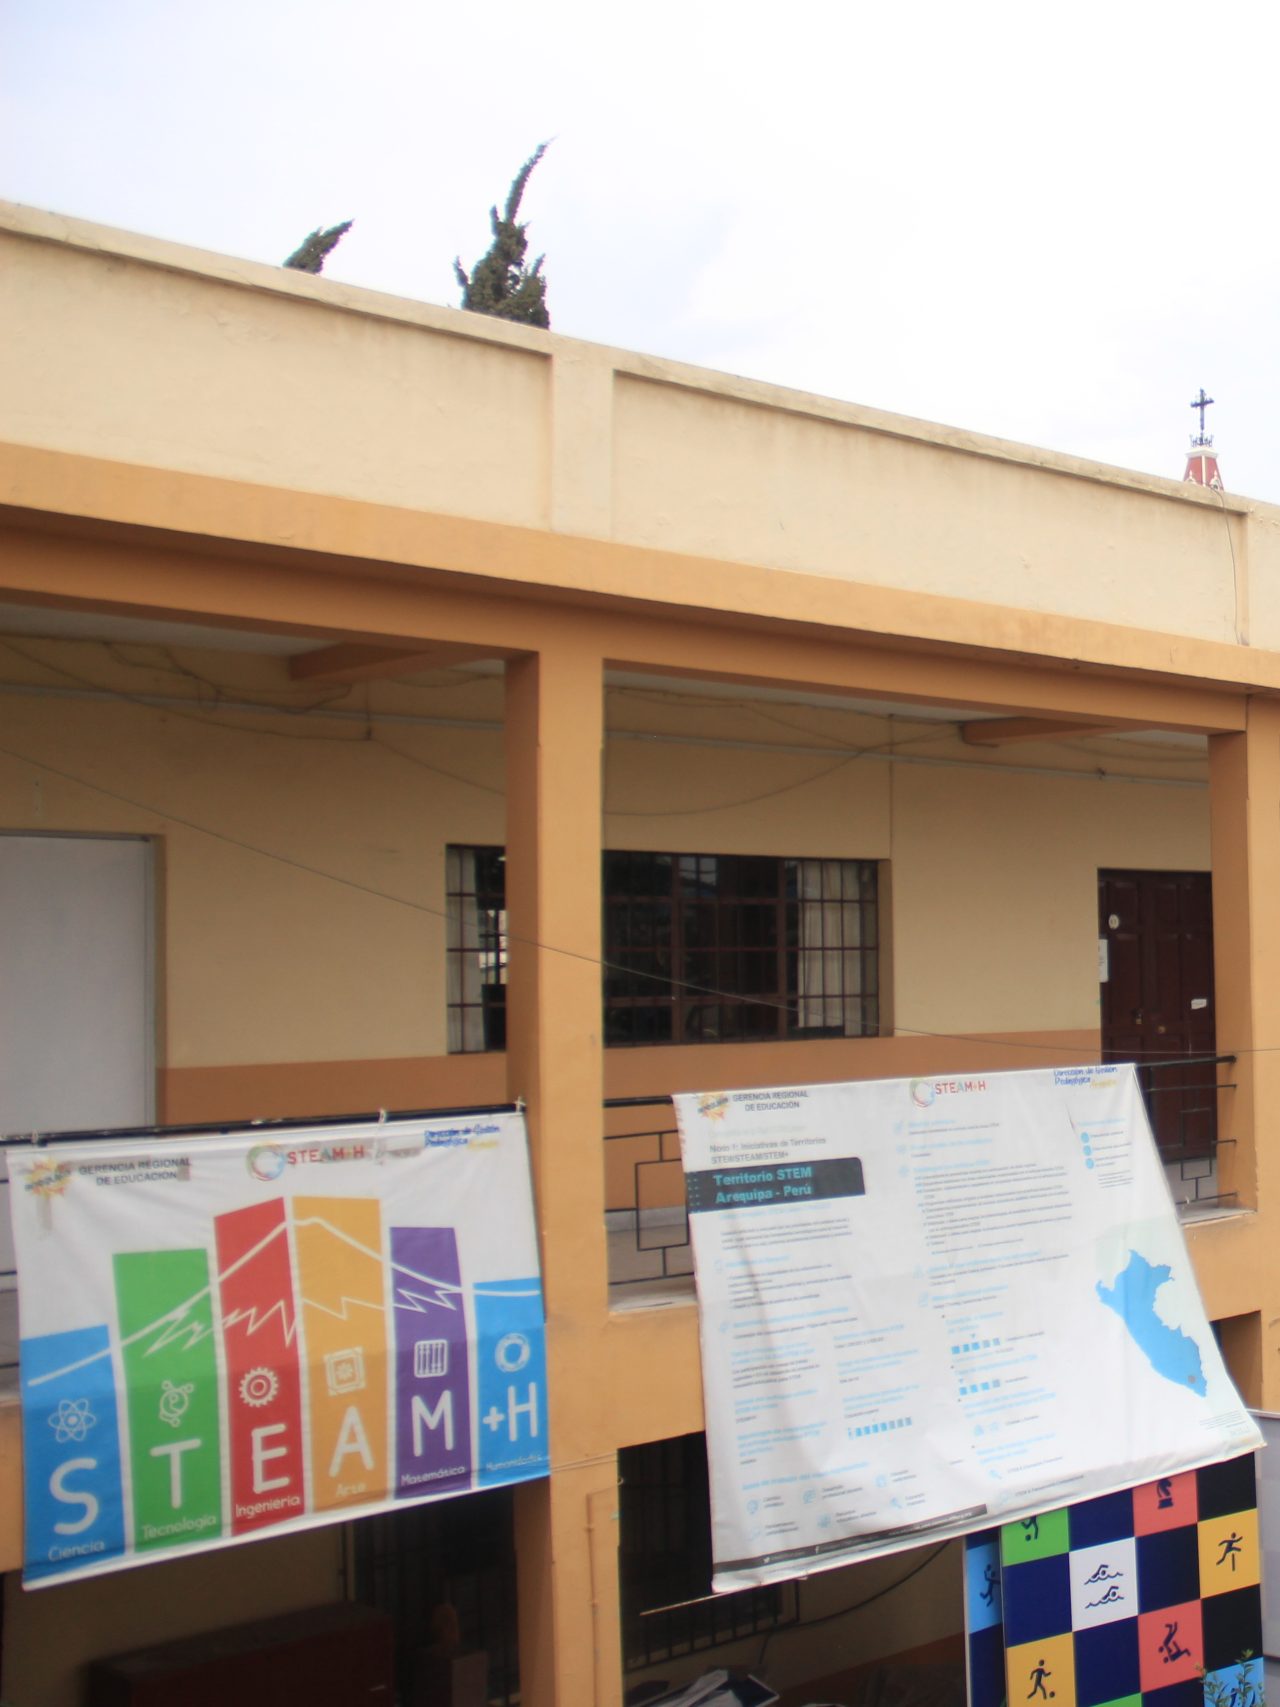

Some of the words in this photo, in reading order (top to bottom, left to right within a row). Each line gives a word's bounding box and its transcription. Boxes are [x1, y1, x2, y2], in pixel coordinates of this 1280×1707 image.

[733, 1092, 771, 1102] GERENCIA
[772, 1090, 809, 1099] REGIONAL
[745, 1103, 756, 1111] DE
[78, 1162, 135, 1175] GERENCIA
[138, 1158, 191, 1169] REGIONAL
[96, 1176, 111, 1186] DE
[713, 1171, 773, 1186] Territorio
[776, 1166, 812, 1181] STEM
[715, 1188, 773, 1204] Arequipa
[783, 1183, 812, 1197] Perú
[50, 1458, 98, 1534] S
[150, 1438, 202, 1509] T
[251, 1423, 291, 1494] E
[328, 1405, 375, 1478] A
[411, 1389, 454, 1457] M
[48, 1539, 105, 1562] Ciencia
